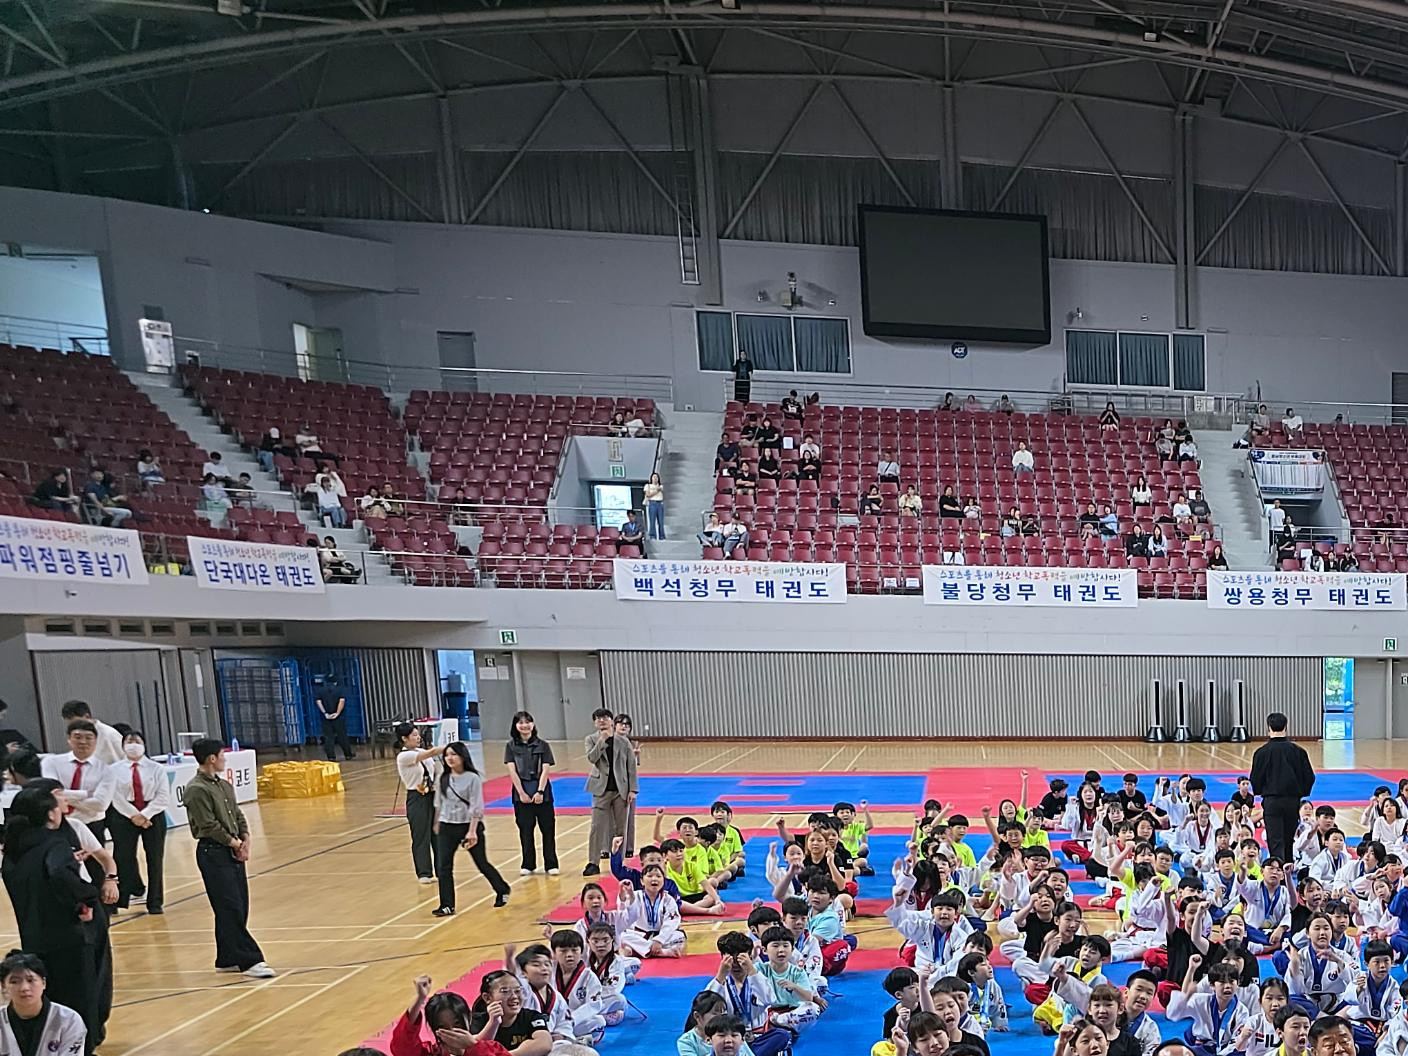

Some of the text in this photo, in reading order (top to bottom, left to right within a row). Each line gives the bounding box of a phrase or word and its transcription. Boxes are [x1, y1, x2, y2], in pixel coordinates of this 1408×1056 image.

[0, 543, 131, 579] 파워점핑줄넘기
[275, 565, 316, 587] 태권도
[632, 564, 829, 578] 스포츠를 통해 청소년 학교폭력을 예방합시다!
[995, 570, 1020, 581] 청소년
[1069, 572, 1121, 582] 예방합시다!
[1275, 574, 1298, 585] 청소년
[1343, 576, 1392, 587] 예방합시다!
[634, 577, 829, 599] 백석청무 태권도
[940, 582, 1121, 602] 불당청무 태권도
[1224, 587, 1392, 606] 쌍용청무 태권도
[1255, 1033, 1283, 1048] FIL
